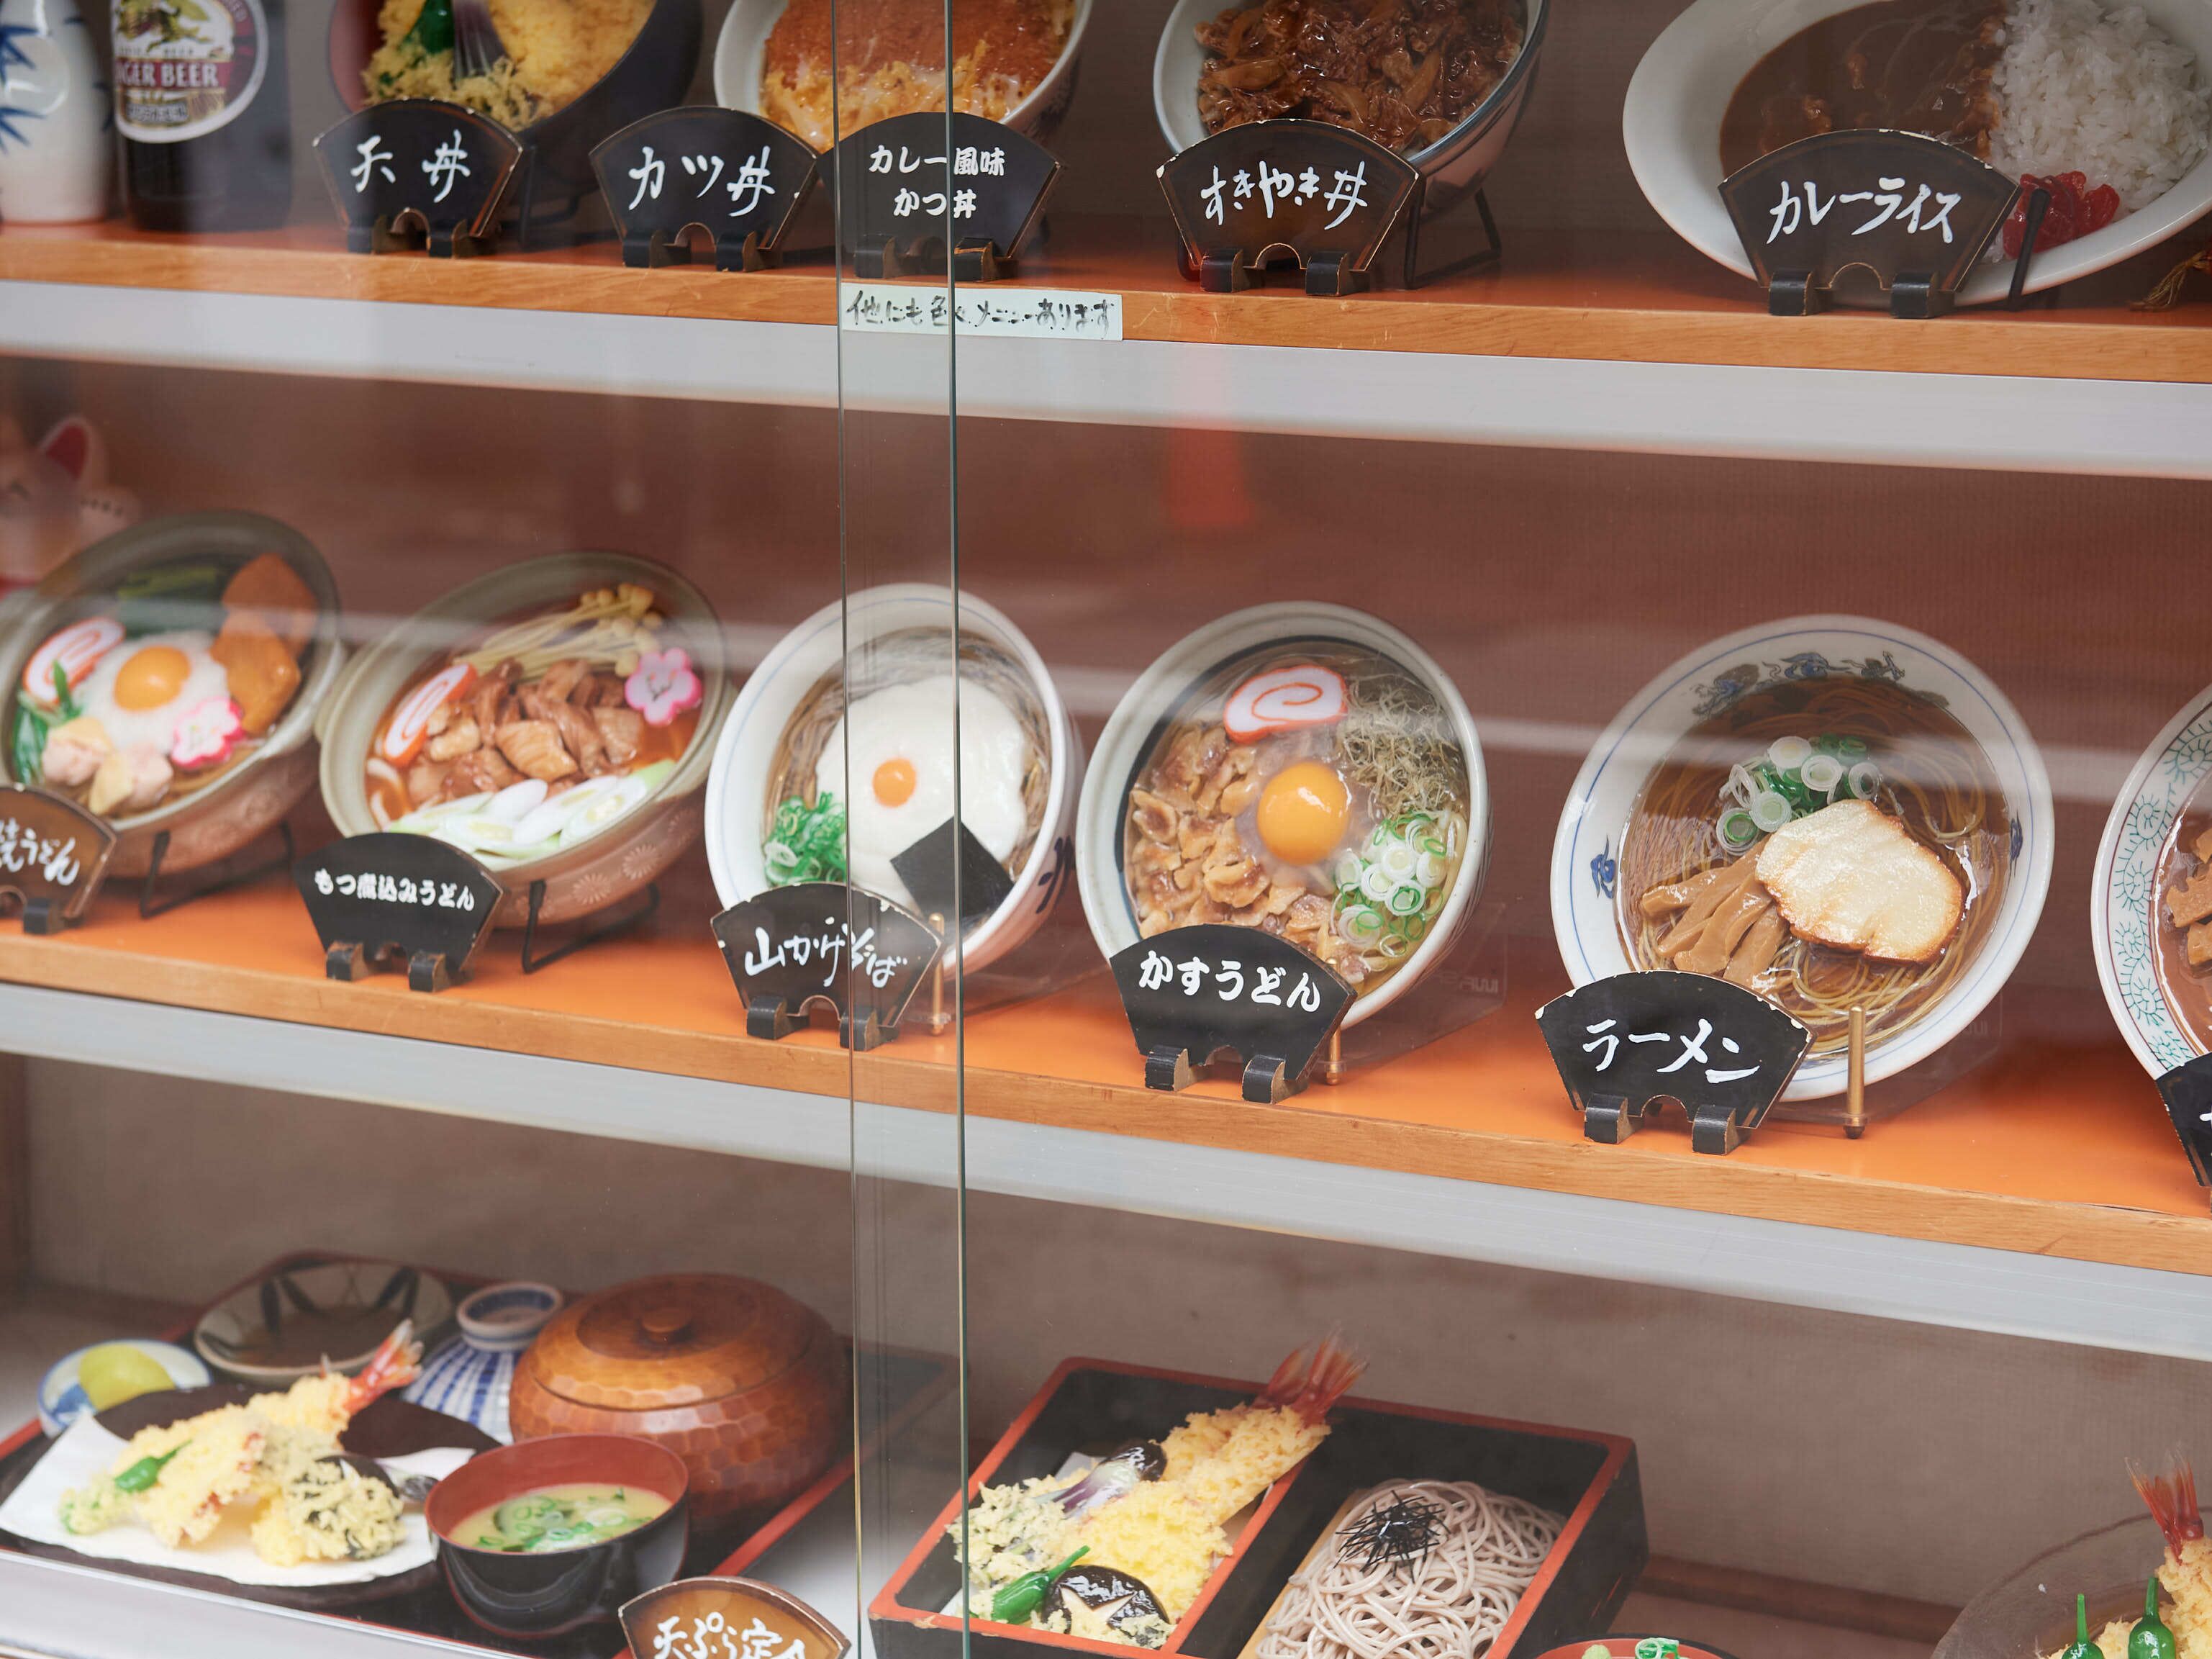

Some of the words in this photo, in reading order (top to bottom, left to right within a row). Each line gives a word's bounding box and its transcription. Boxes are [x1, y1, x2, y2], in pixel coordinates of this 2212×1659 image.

[160, 63, 218, 87] BEER
[350, 130, 471, 202] 天丼
[628, 146, 775, 217] カツ丼
[869, 145, 1005, 176] カレー風味
[893, 188, 976, 219] かつ丼
[1200, 161, 1368, 230] すきやき丼
[1766, 177, 1962, 244] カレーライス
[314, 868, 475, 911] もつ煮込みうどん
[1138, 949, 1322, 1013] かすうどん
[1582, 1018, 1760, 1084] ラーメン
